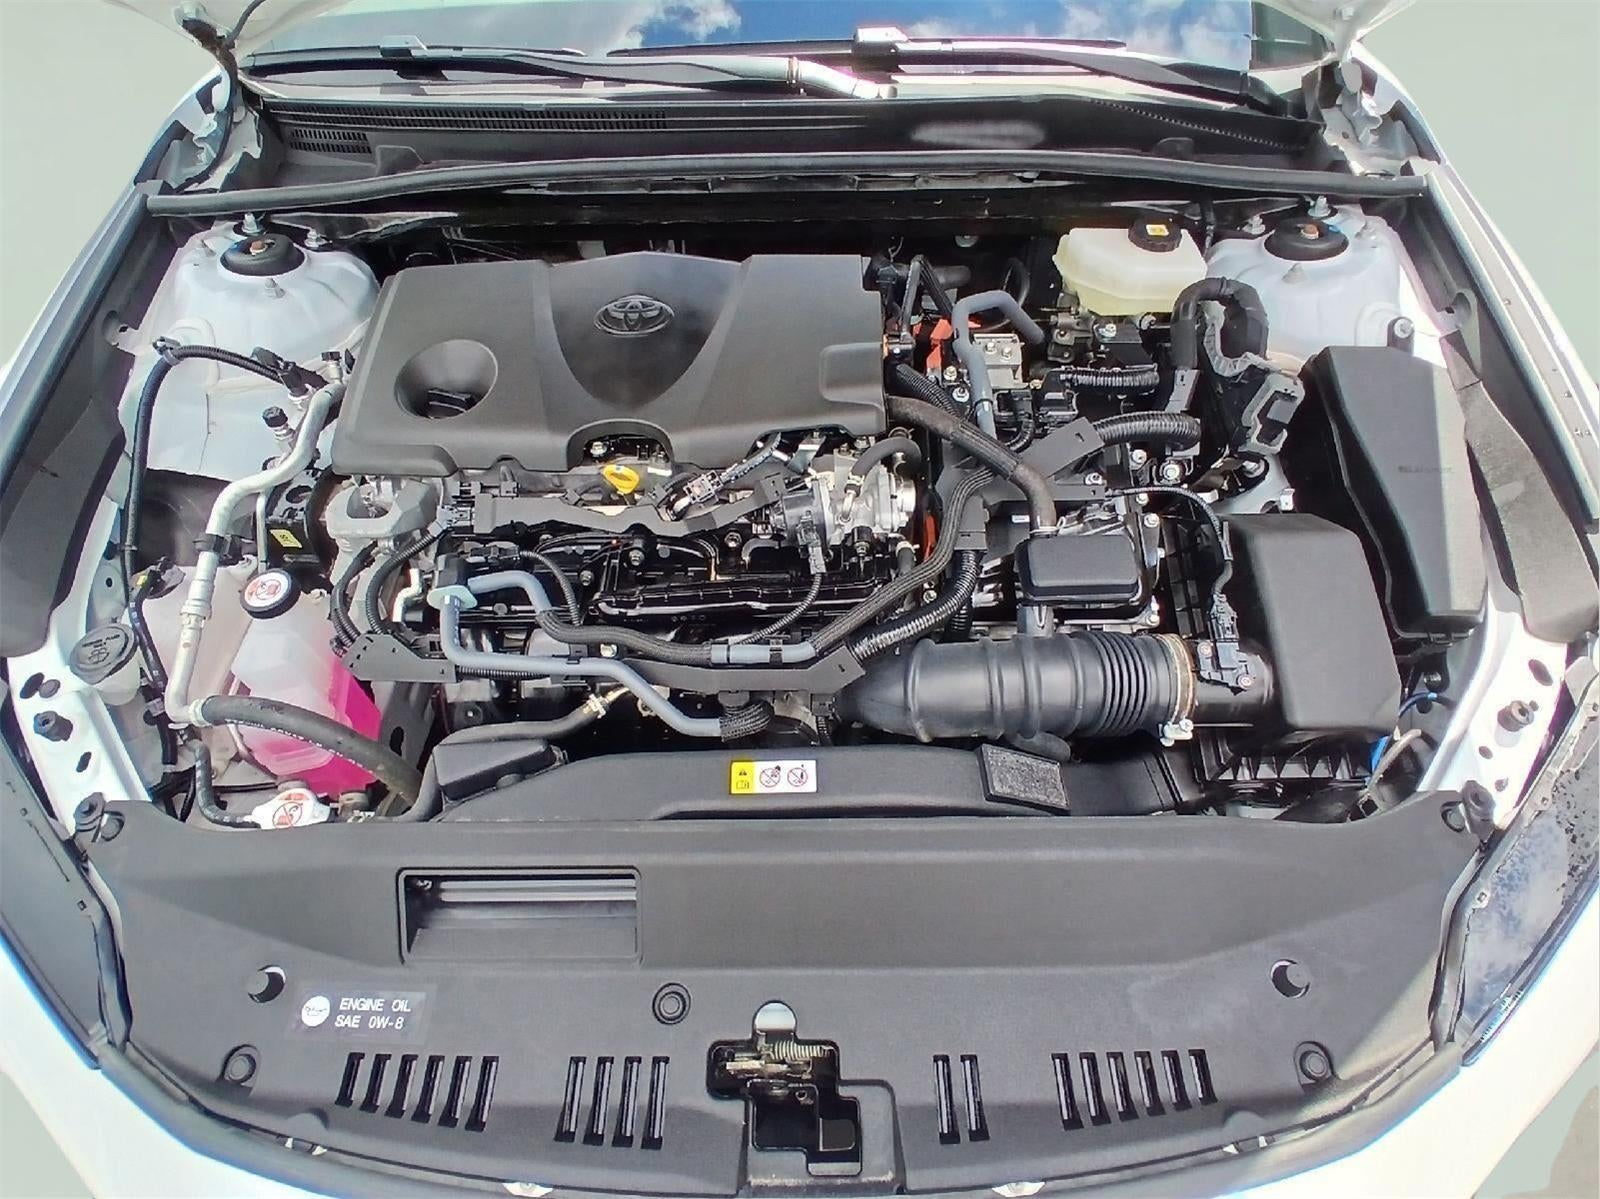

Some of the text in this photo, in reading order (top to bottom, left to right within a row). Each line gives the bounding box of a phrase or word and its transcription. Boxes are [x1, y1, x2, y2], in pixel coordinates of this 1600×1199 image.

[339, 997, 411, 1012] ENGINE OIL
[334, 1014, 405, 1030] SAE 0W-8
